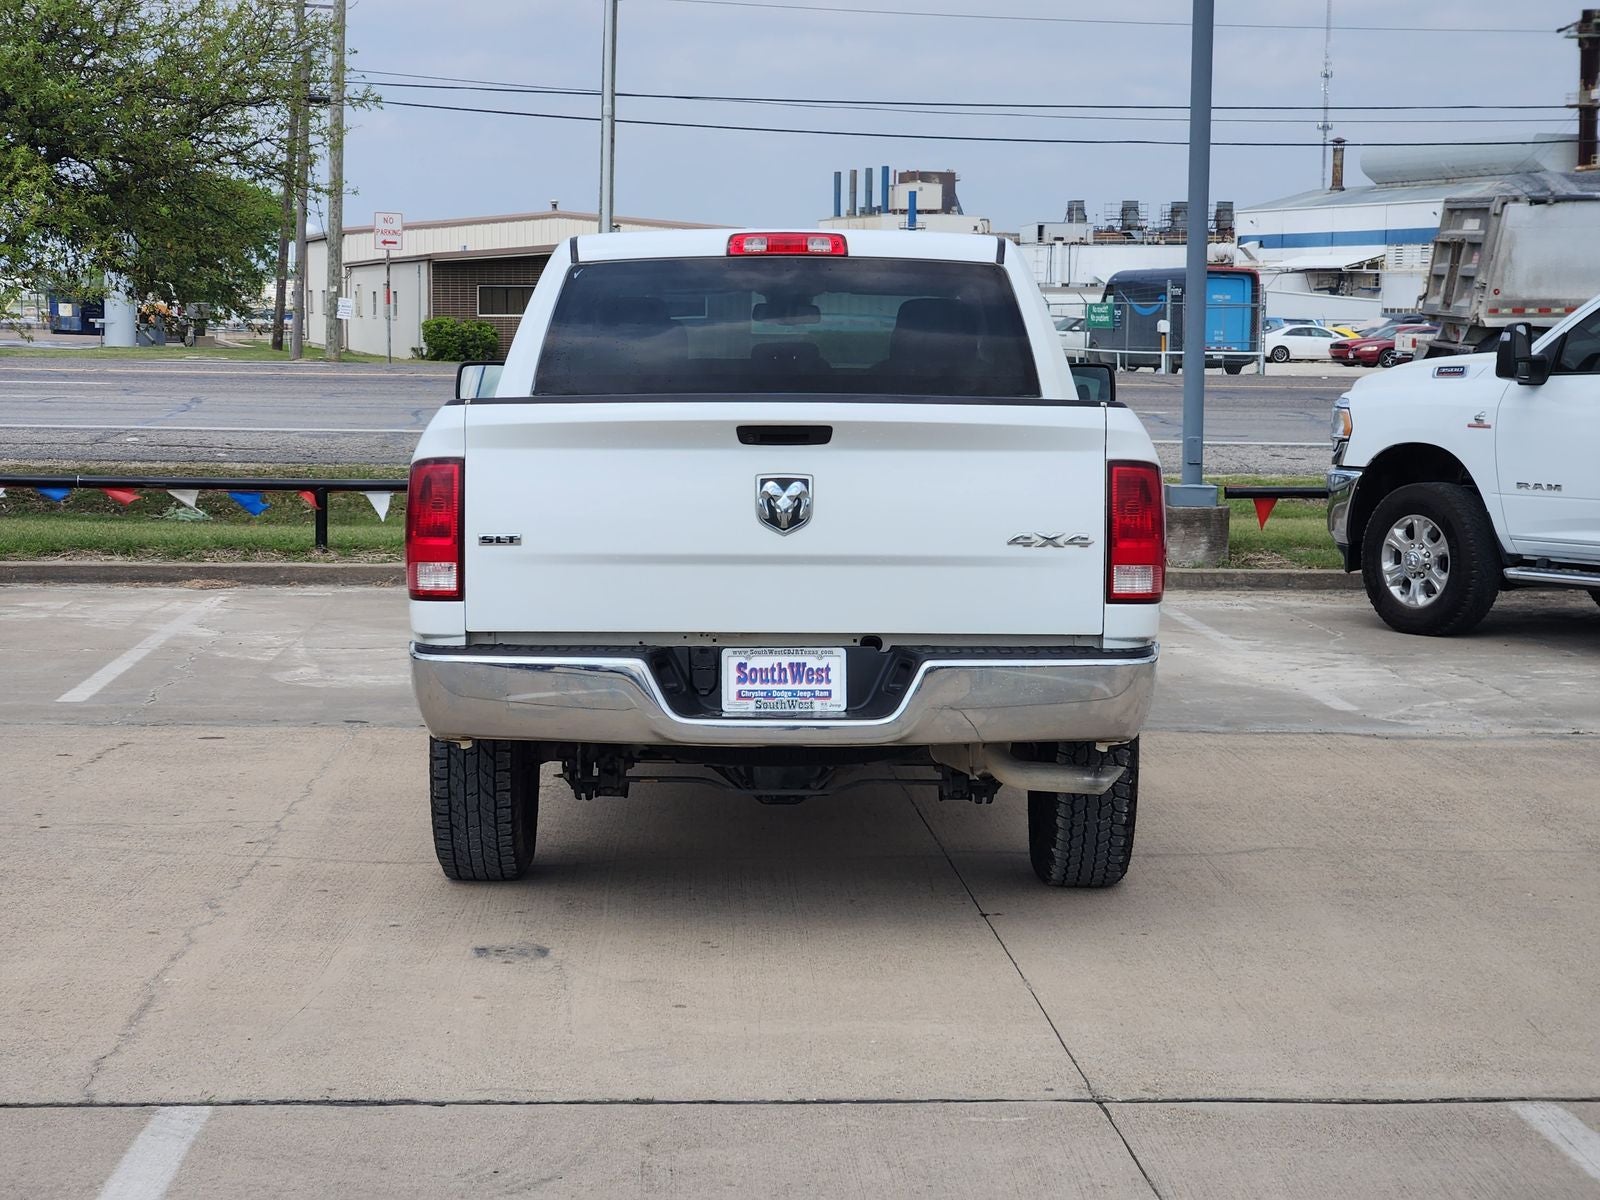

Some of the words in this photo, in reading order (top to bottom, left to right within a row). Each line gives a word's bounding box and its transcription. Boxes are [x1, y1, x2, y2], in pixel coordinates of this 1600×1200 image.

[383, 216, 394, 225] NO
[376, 228, 401, 237] PARKING
[1516, 482, 1562, 492] RAM
[481, 535, 519, 544] SLT
[736, 661, 832, 685] SouthWest
[741, 690, 767, 698] Chrysler
[772, 690, 792, 698] Dodge
[797, 690, 811, 698] Jeep
[755, 699, 814, 710] SouthWest
